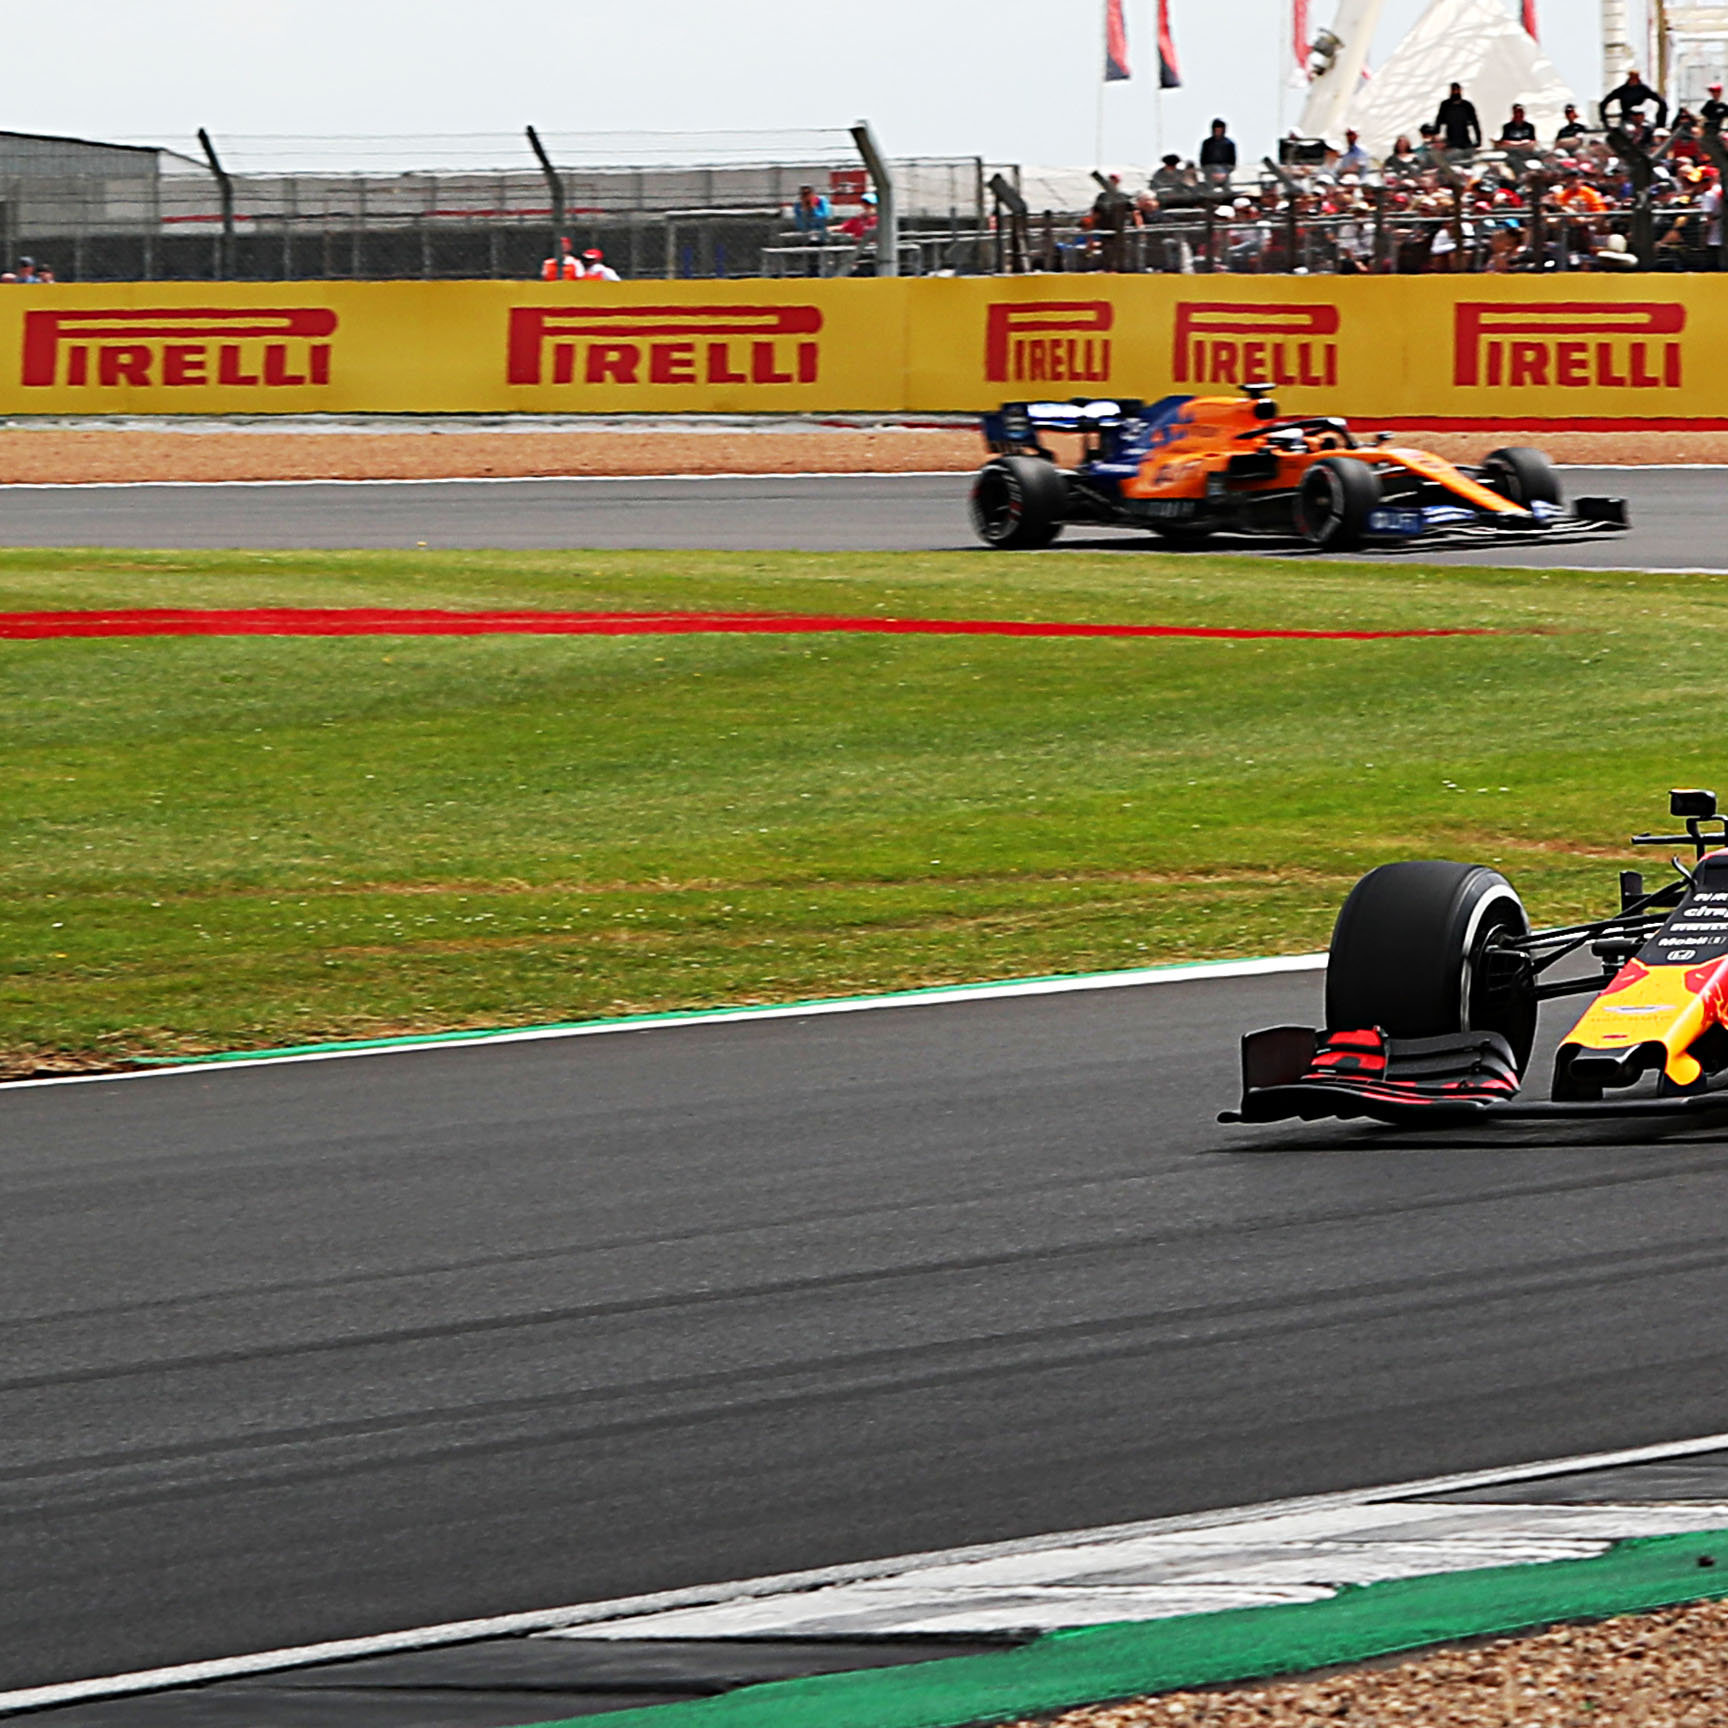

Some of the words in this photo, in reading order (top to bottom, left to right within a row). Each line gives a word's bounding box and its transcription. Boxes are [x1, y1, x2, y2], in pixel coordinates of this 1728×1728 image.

[21, 307, 339, 388] PIRELLI
[506, 305, 824, 386] PIRELLI
[985, 300, 1114, 383] PIRELLI
[1172, 301, 1341, 388] PIRELLI
[1453, 301, 1687, 389] PIRELLI
